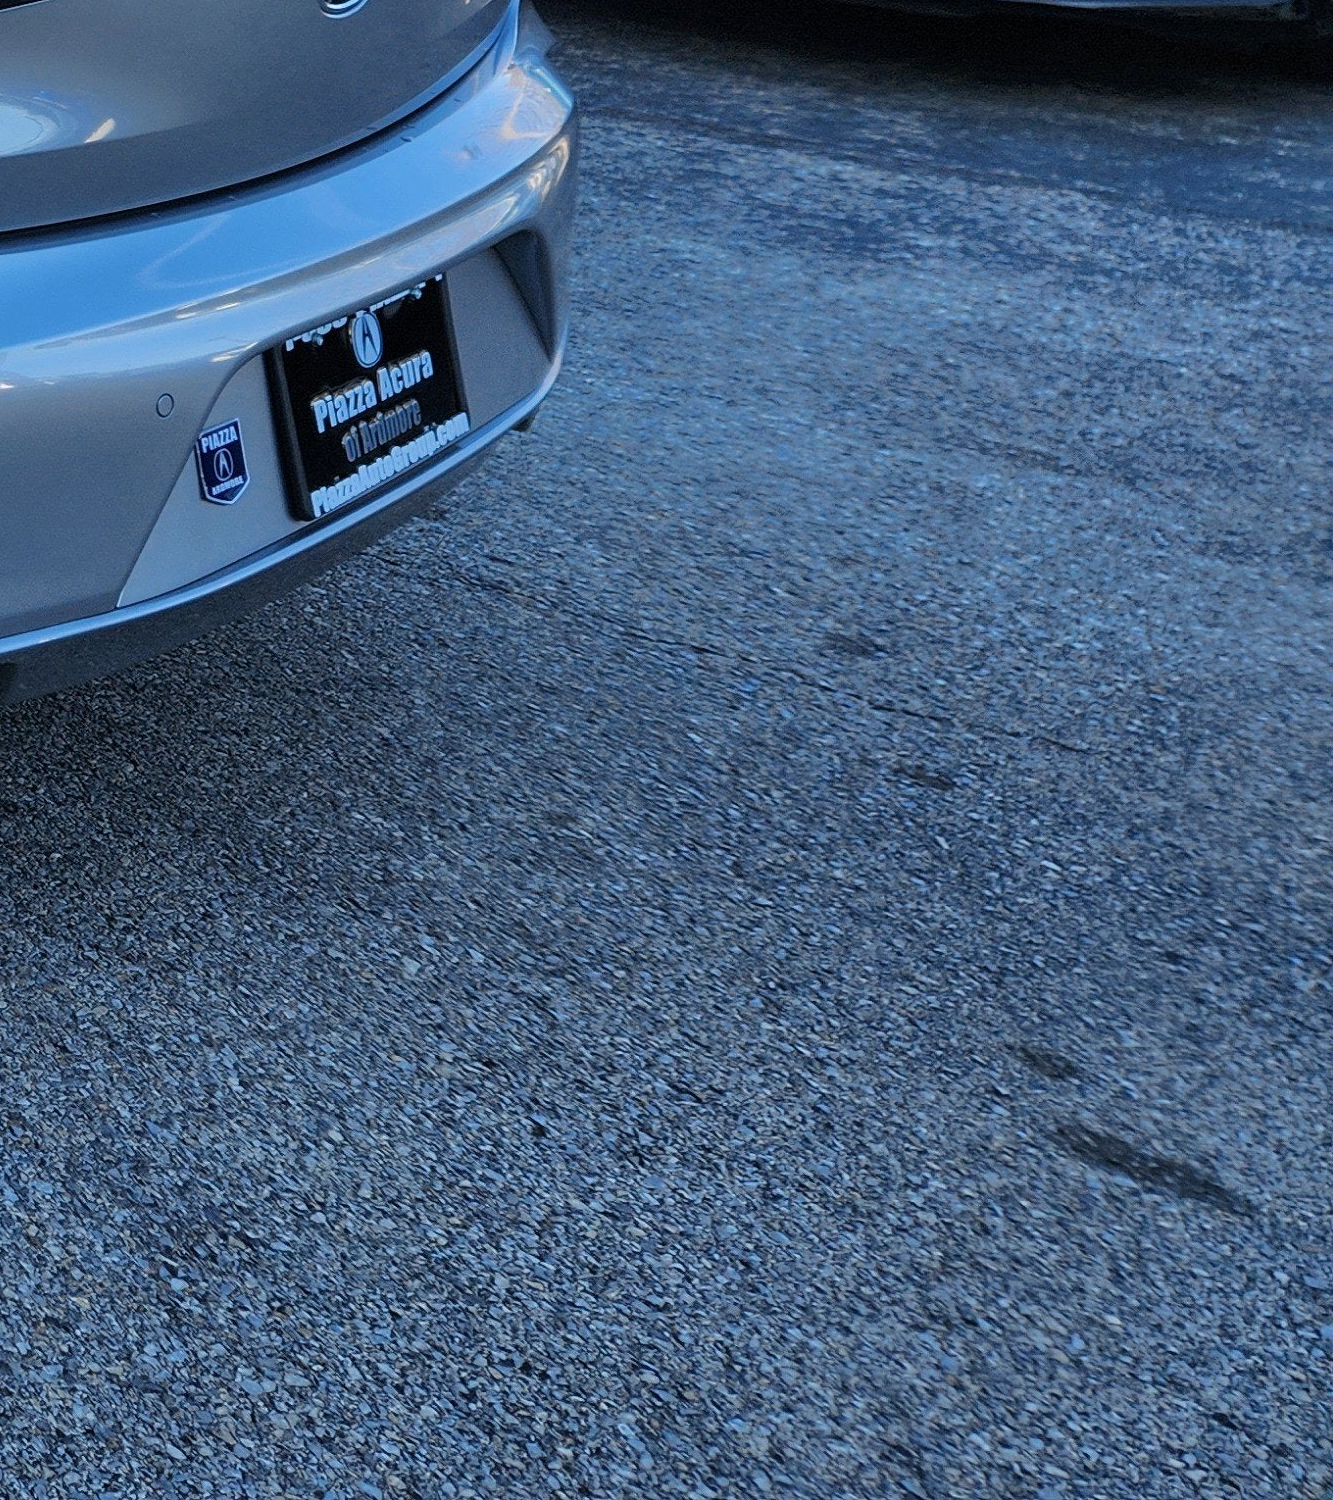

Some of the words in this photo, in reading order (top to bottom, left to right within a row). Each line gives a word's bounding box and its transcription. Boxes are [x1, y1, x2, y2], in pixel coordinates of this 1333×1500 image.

[312, 378, 378, 434] Piazza
[376, 349, 435, 402] Acura
[201, 425, 239, 454] PIAZZA
[310, 411, 471, 518] PiazzaAutoGroup.com
[342, 425, 362, 463] of
[359, 398, 422, 453] Ardmore
